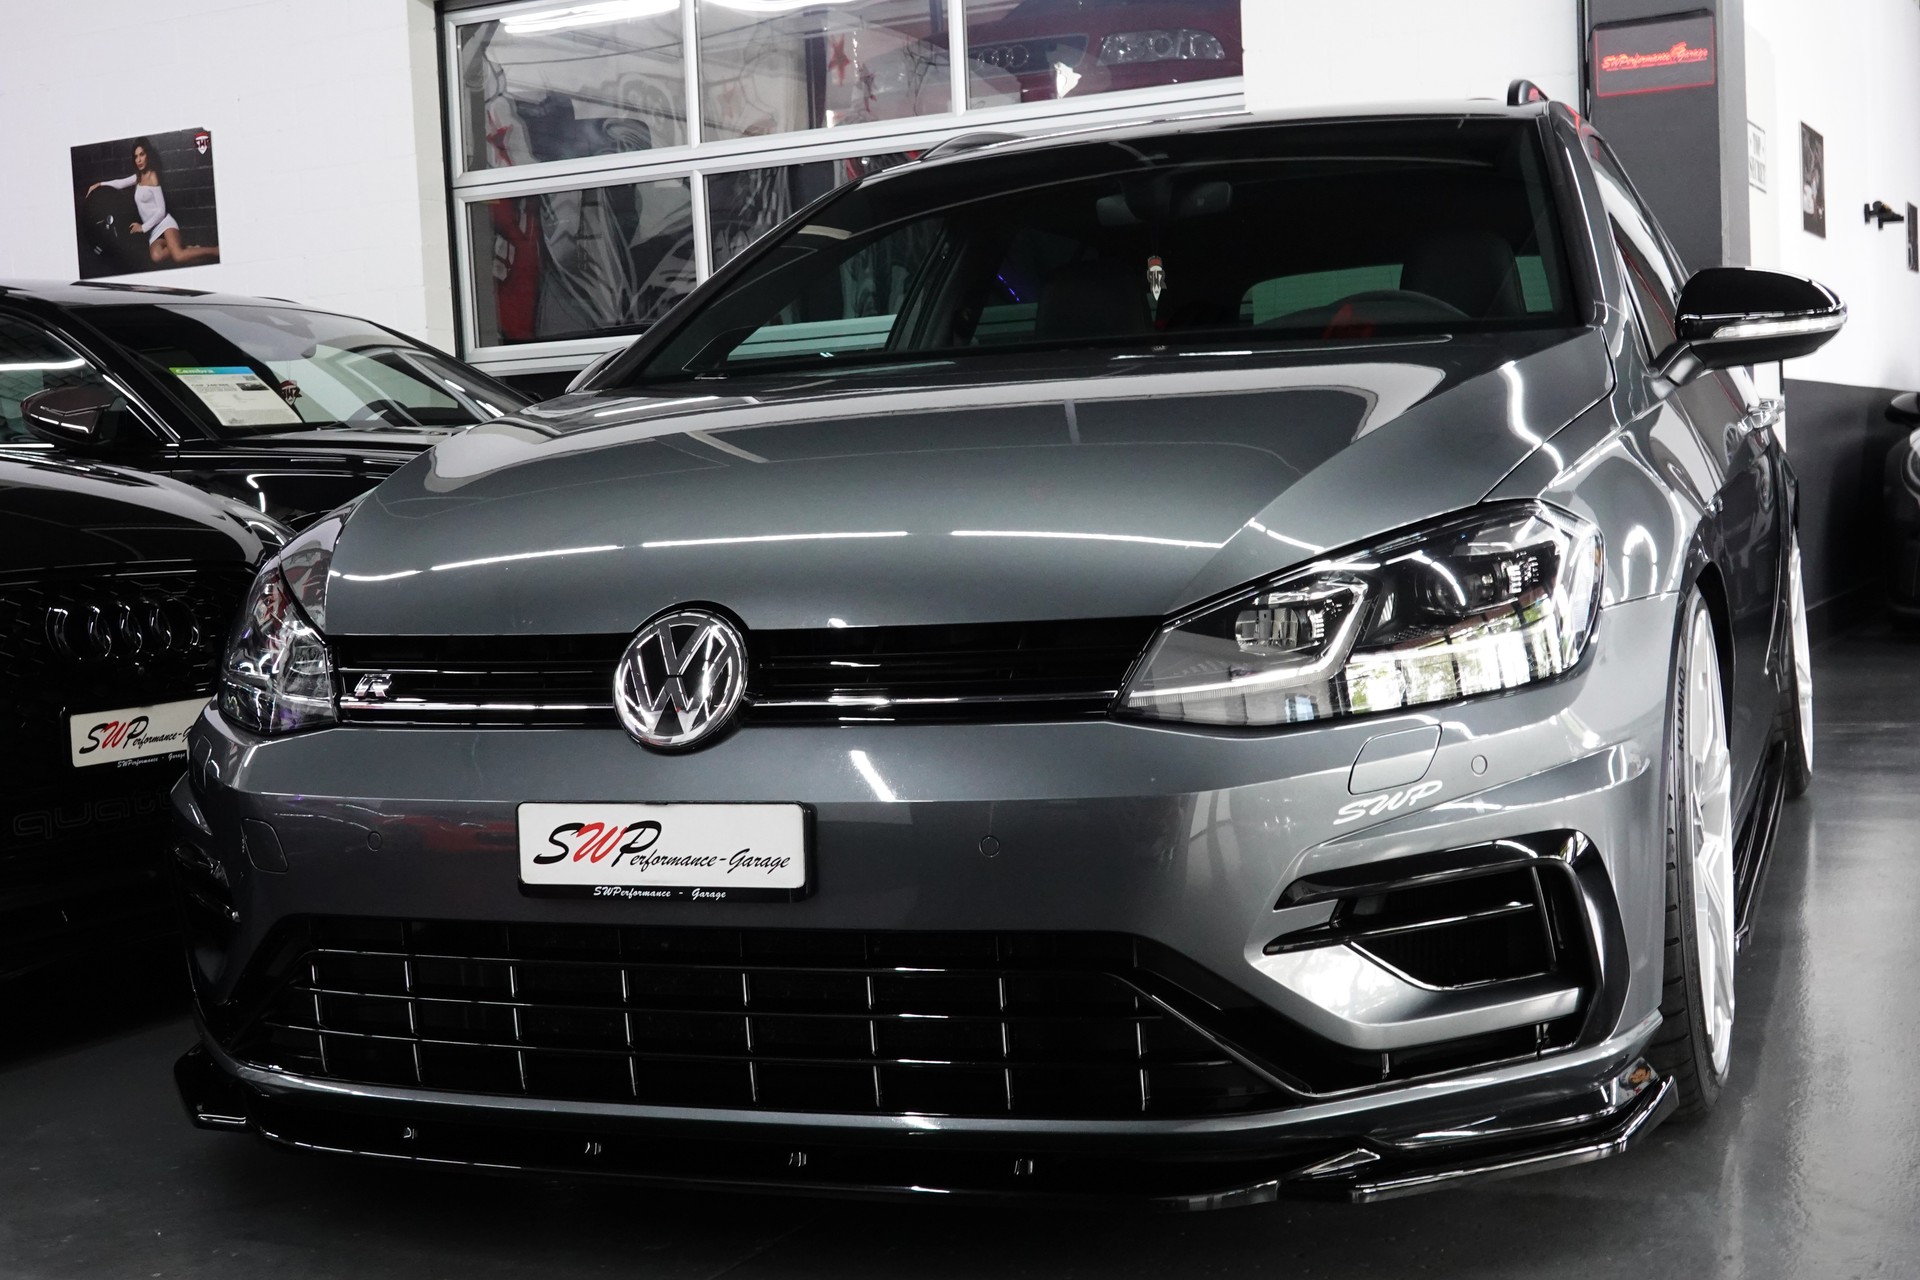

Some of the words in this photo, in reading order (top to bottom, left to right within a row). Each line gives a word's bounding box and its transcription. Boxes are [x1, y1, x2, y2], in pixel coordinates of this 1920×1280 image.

[353, 673, 392, 699] R
[1678, 665, 1686, 752] KUMHO
[117, 757, 159, 768] SWPerformance
[167, 752, 186, 762] Garage
[1332, 780, 1443, 825] SWP
[593, 886, 671, 899] SWPerformance
[691, 887, 727, 900] Garage
